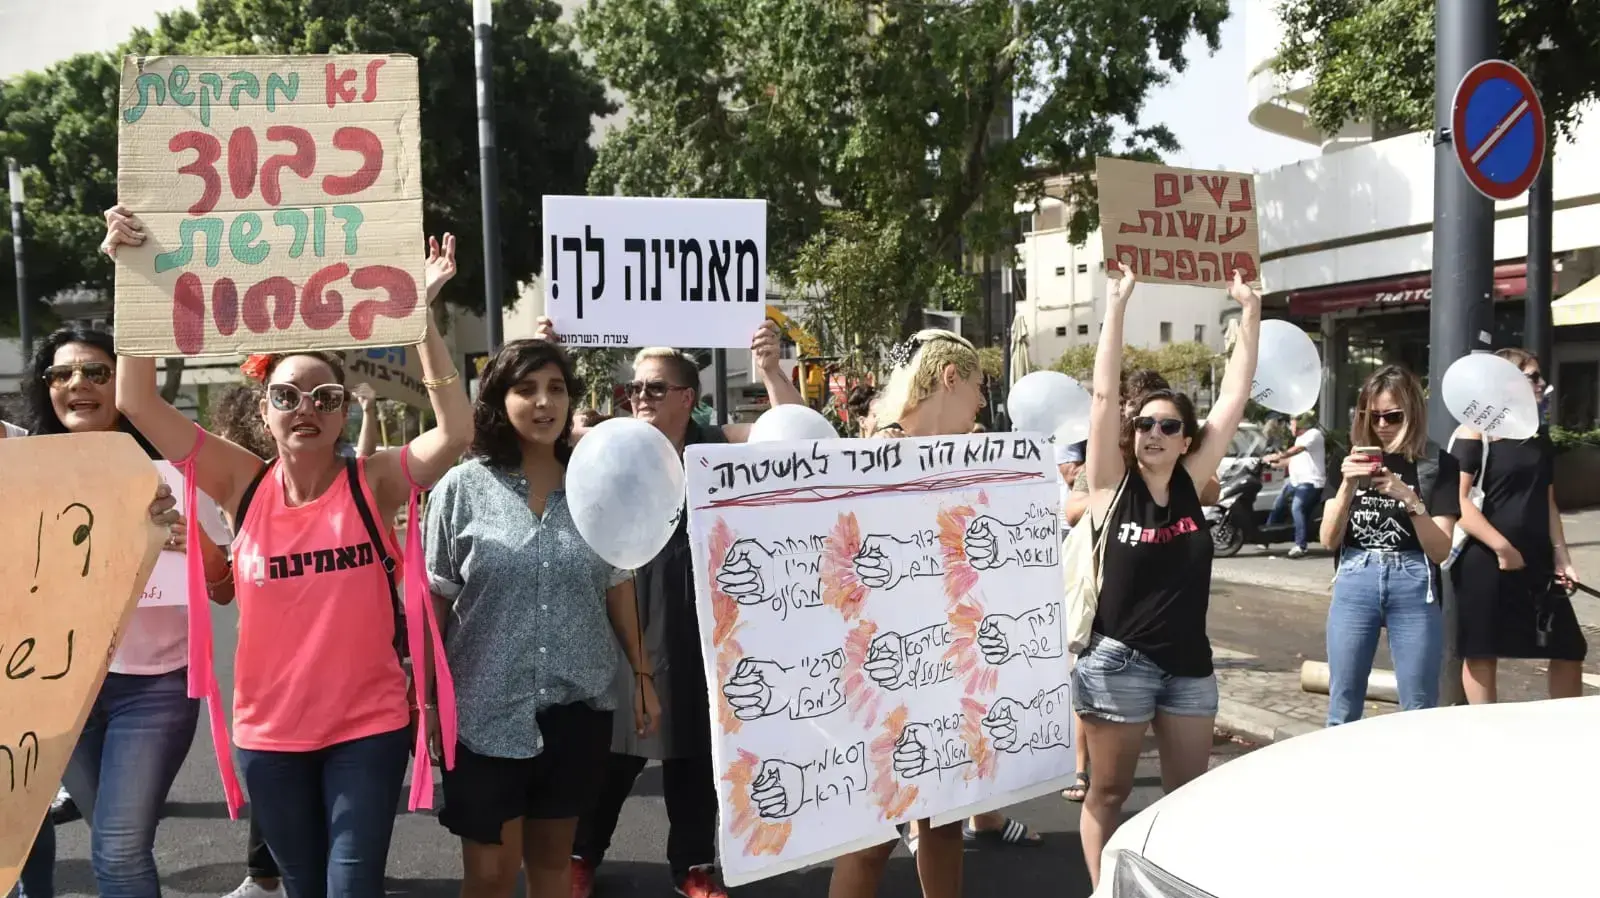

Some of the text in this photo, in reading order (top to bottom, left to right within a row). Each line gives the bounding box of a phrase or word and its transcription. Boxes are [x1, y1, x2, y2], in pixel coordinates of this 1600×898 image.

[123, 59, 386, 127] לא מבקשת
[1154, 173, 1252, 212] נשים
[155, 205, 364, 273] דורשת
[1118, 209, 1247, 244] עושות
[551, 225, 759, 319] מאמינה לך!
[173, 262, 418, 355] בטחון
[1375, 288, 1432, 302] TRATTO
[560, 333, 599, 344] השרמוט
[842, 441, 902, 474] מוכר
[964, 437, 1004, 467] הוא
[269, 542, 374, 580] מאמינה
